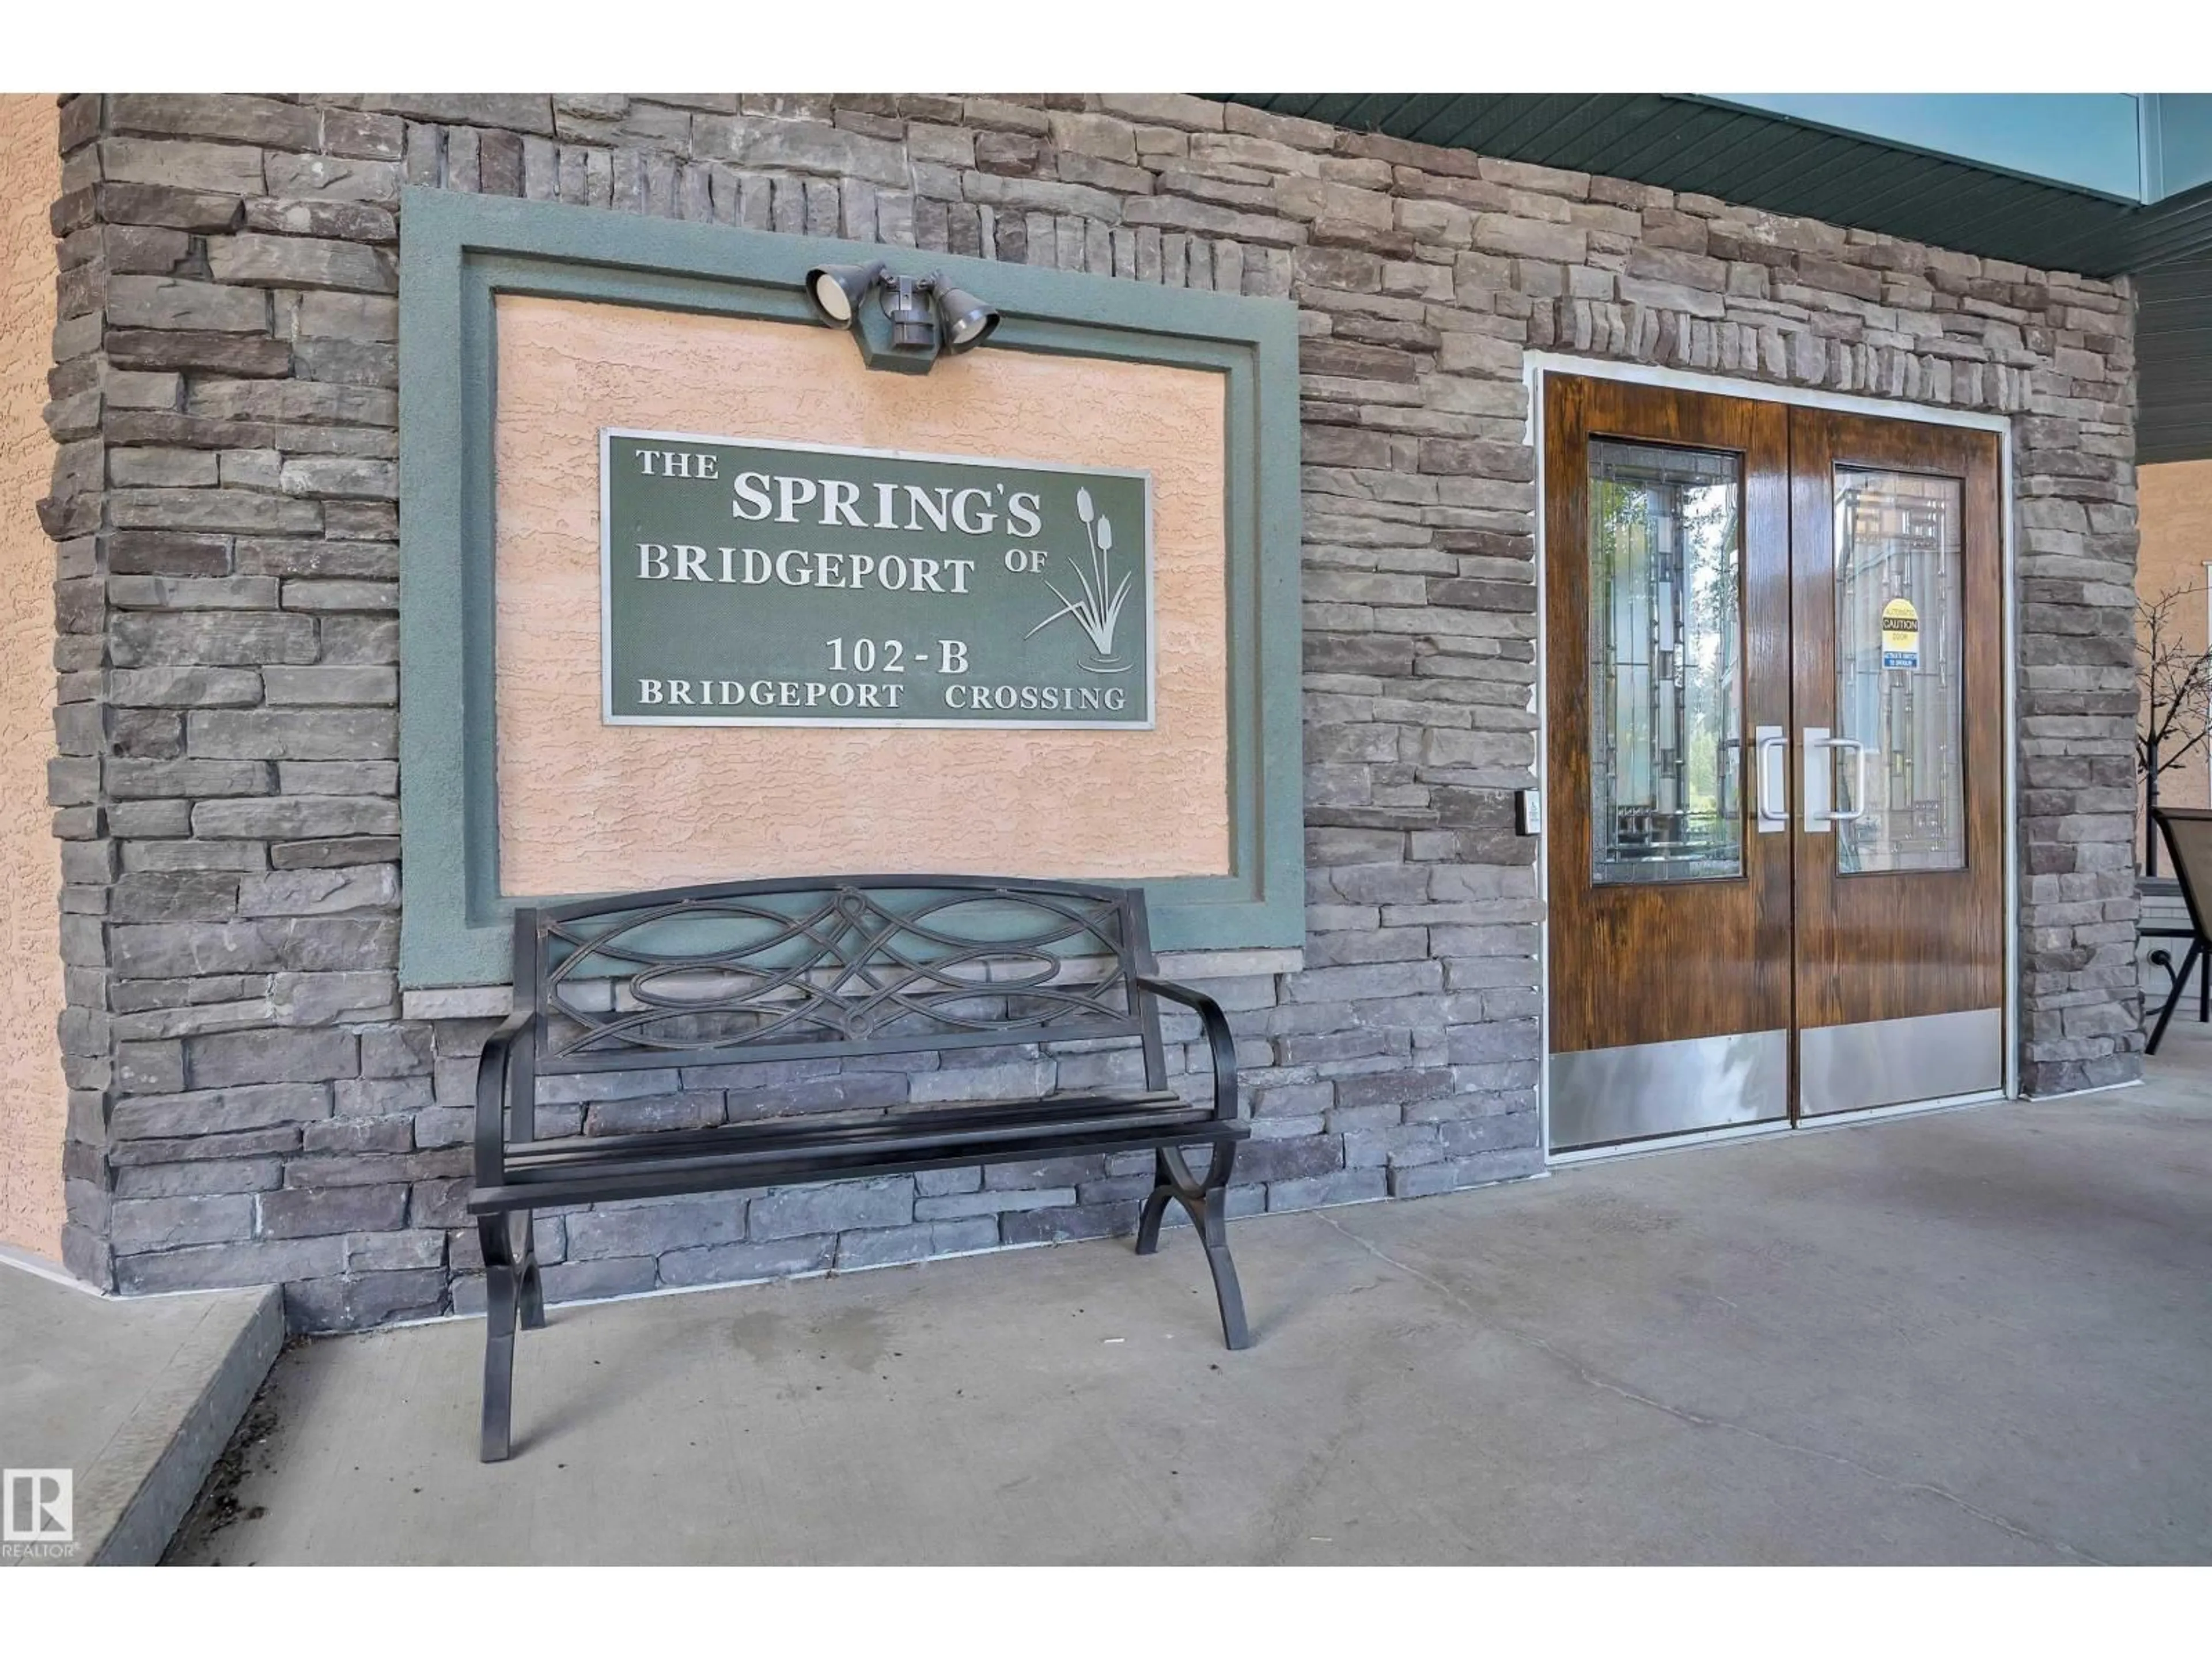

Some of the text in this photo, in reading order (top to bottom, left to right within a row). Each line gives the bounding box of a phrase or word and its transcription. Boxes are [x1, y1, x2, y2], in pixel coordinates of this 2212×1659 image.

[635, 449, 1042, 537] THE SPRING'S
[637, 543, 975, 594] BRIDGEPORT
[1004, 548, 1048, 574] OF
[1883, 619, 1917, 630] CAUTION
[638, 678, 1126, 710] BRIDGEPORT CROSSING
